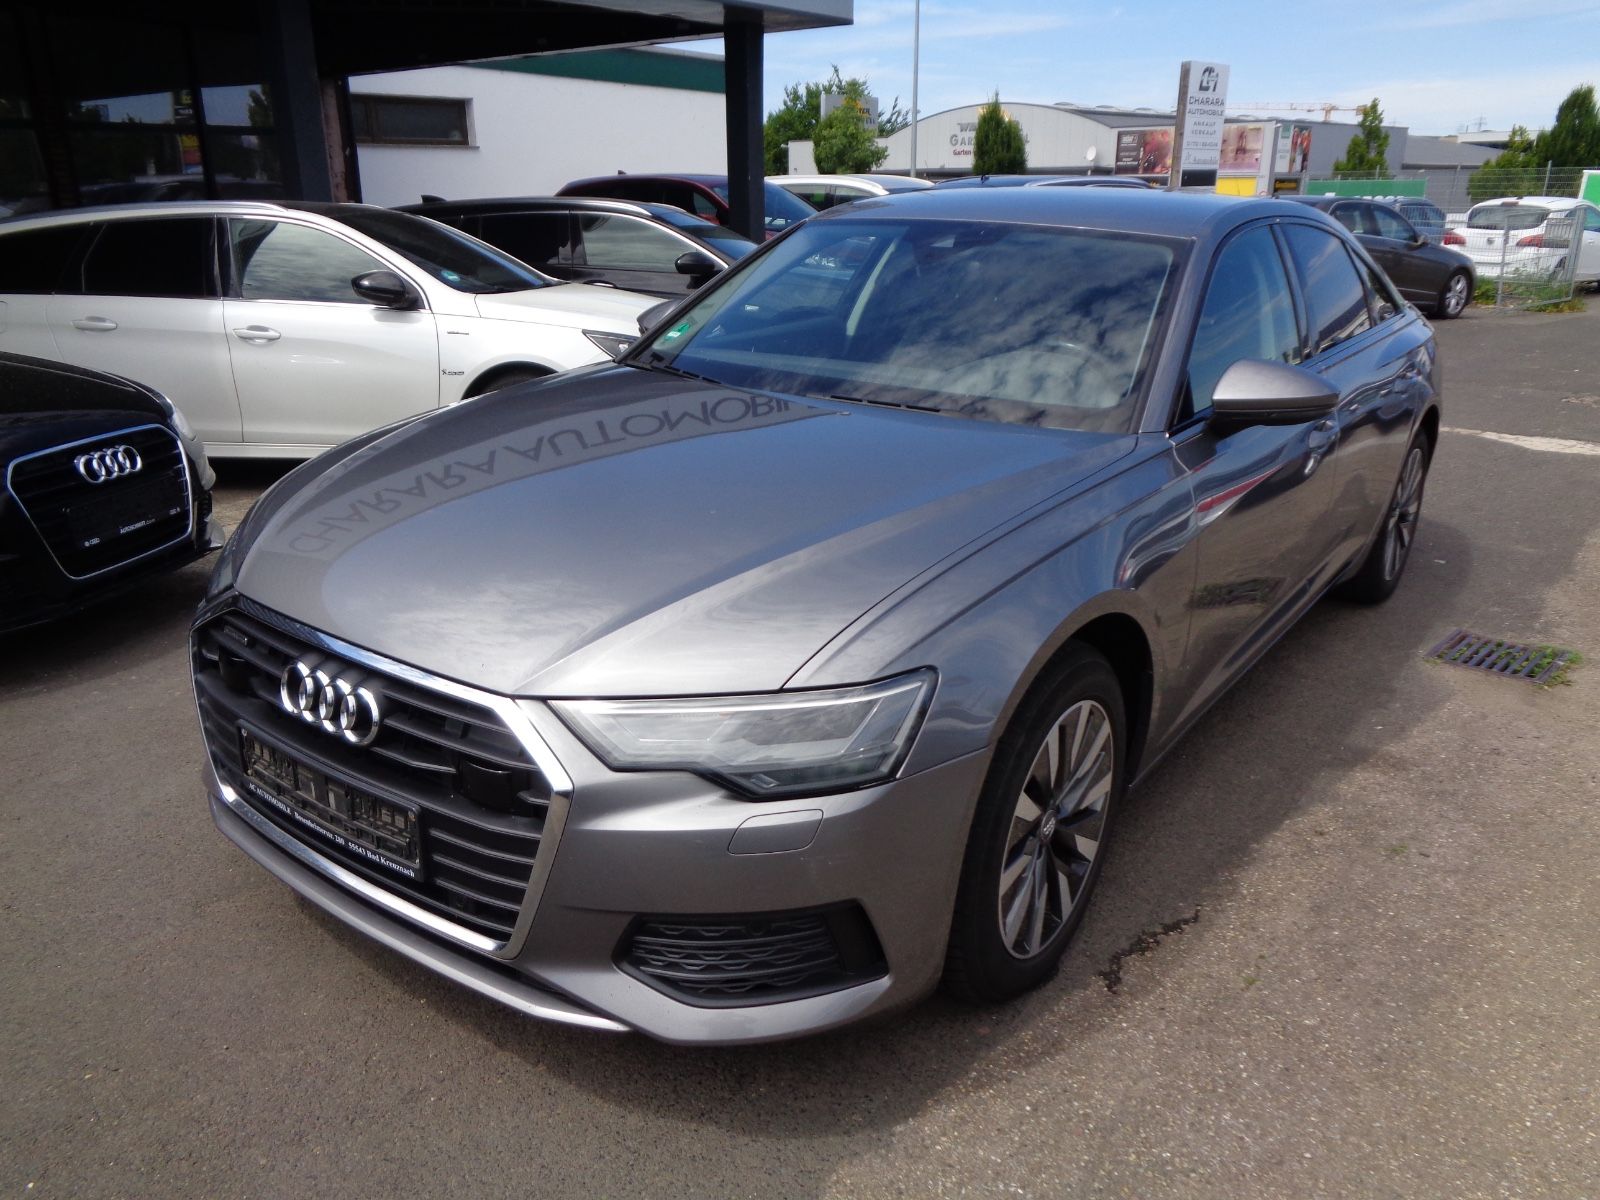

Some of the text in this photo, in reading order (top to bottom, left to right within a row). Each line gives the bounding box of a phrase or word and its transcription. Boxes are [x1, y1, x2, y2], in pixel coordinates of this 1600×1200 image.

[1188, 96, 1225, 107] CHARARA
[1187, 108, 1224, 117] AUTOMOBILE
[380, 856, 415, 878] Kreuznach
